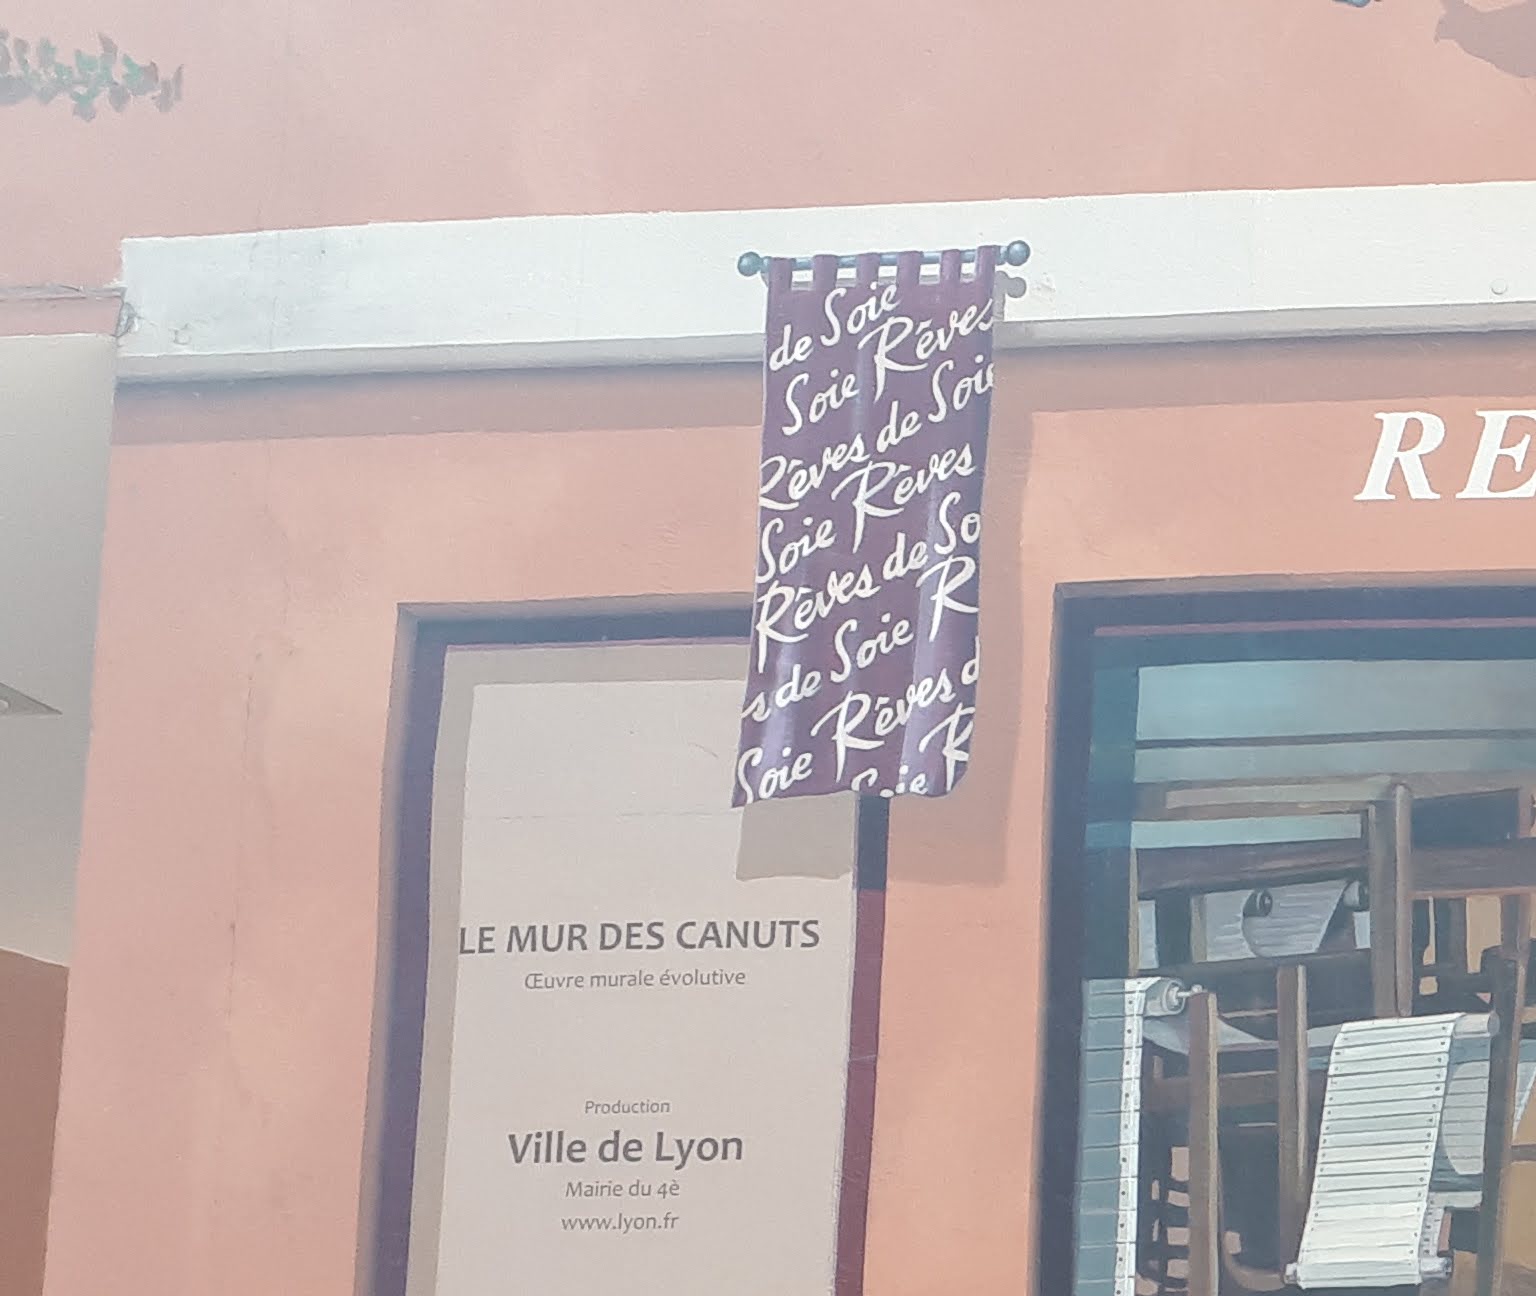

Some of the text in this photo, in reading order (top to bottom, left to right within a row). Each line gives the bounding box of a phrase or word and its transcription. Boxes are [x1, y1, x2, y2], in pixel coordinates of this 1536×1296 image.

[769, 282, 901, 371] de Soie
[782, 369, 859, 436] Soie
[876, 400, 923, 452] de
[756, 516, 835, 584] Soie
[882, 532, 929, 580] de
[775, 613, 914, 708] de Soie
[459, 920, 820, 954] LE MUR DES CANUTS
[524, 967, 745, 990] Œuvre murale évolutive
[585, 1100, 670, 1114] Production
[508, 1130, 743, 1170] Ville de Lyon
[565, 1180, 680, 1199] Mairie du 4è
[561, 1212, 679, 1234] www.lyon.fr
